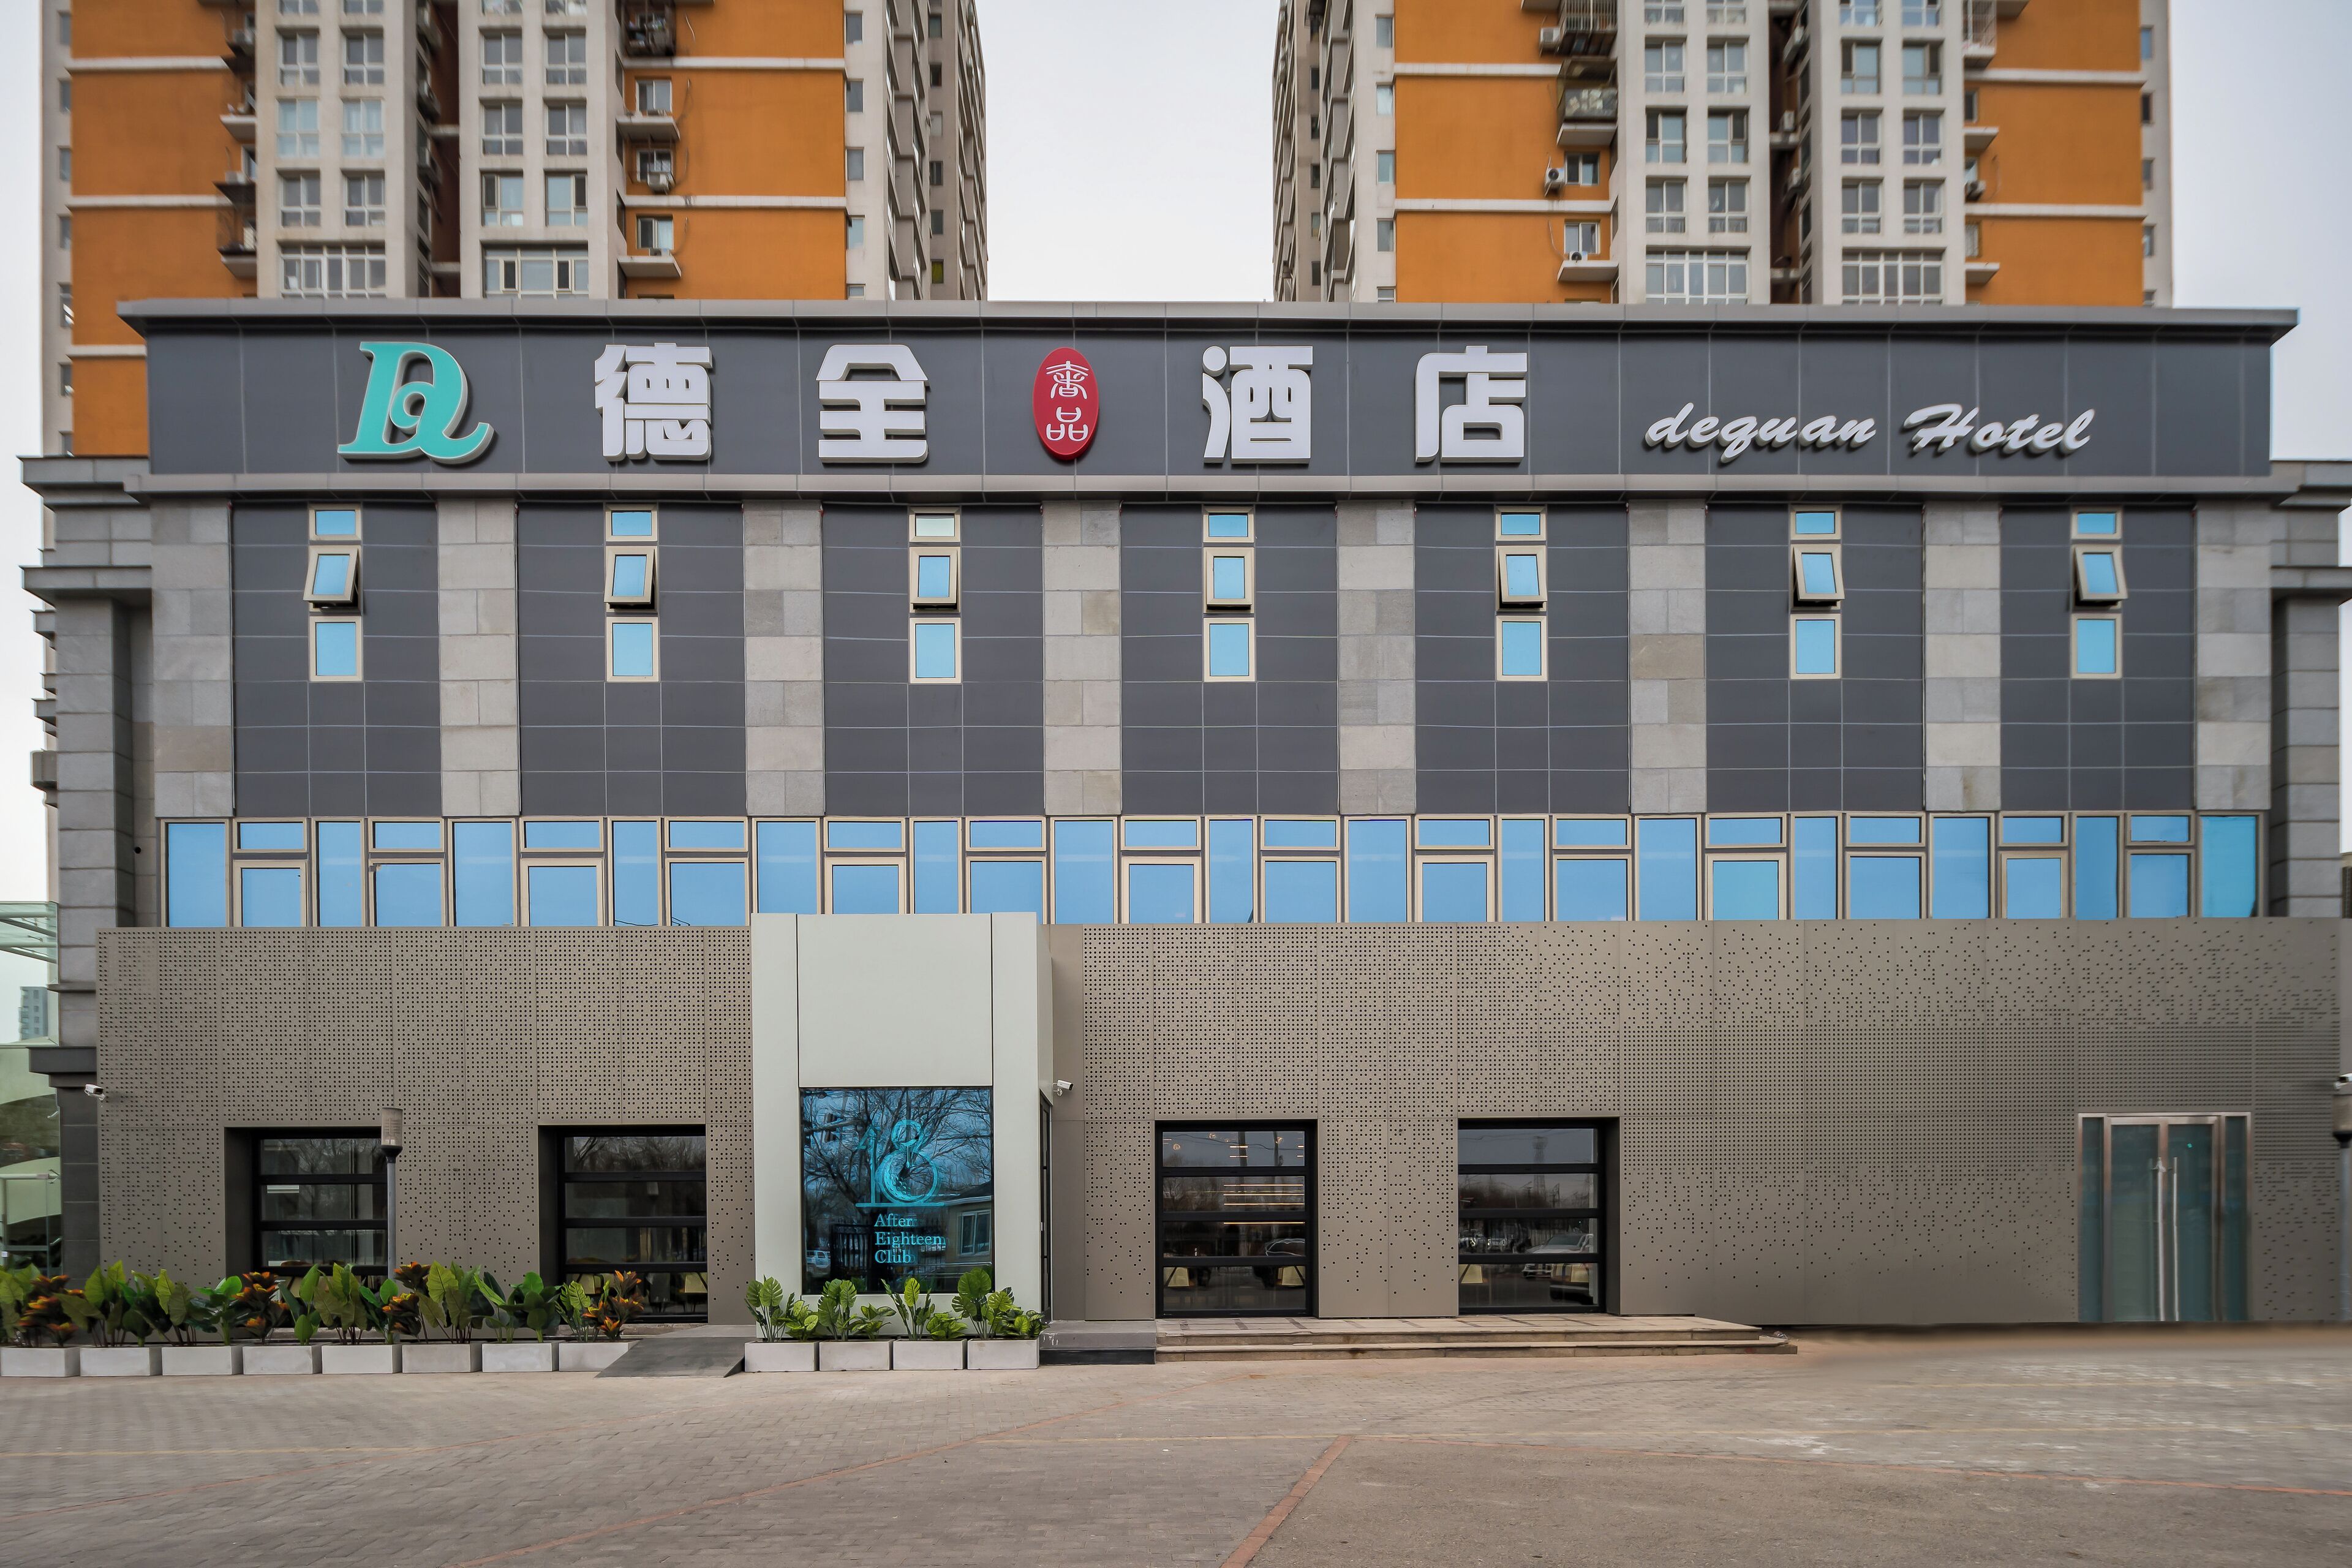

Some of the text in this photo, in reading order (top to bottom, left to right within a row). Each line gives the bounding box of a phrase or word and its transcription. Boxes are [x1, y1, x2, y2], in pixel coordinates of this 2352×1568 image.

[1202, 345, 1527, 463] 酒店
[1645, 402, 2096, 464] dequan Hotel
[874, 1213, 913, 1227] After
[875, 1231, 943, 1248] Eighteen
[875, 1250, 911, 1264] Club
